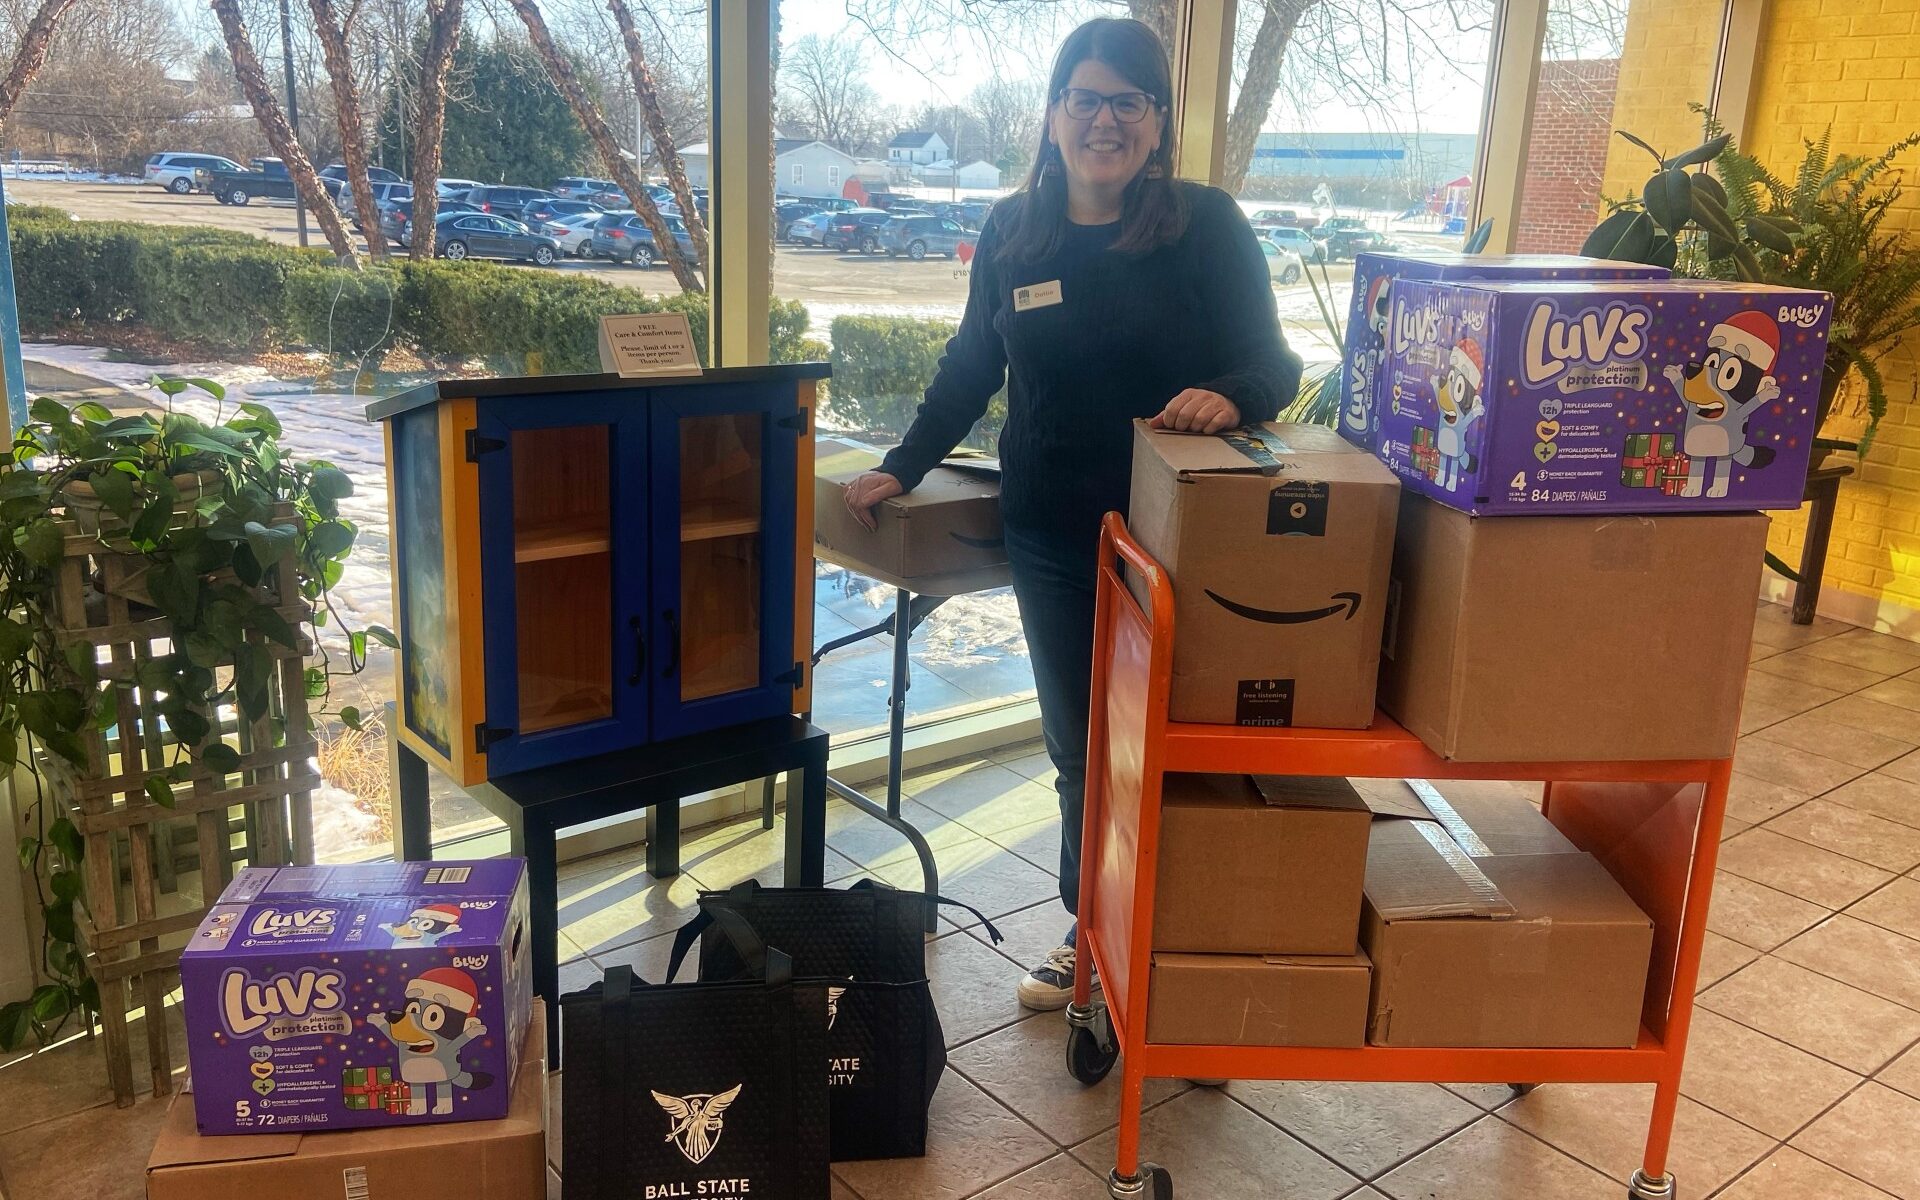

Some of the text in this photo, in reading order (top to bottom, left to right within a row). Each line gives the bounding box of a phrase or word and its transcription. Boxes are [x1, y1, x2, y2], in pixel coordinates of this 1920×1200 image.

[1778, 304, 1824, 328] BLUEY
[643, 343, 659, 351] limit
[1606, 365, 1640, 374] platinum
[1566, 374, 1640, 387] protection
[1542, 406, 1558, 415] 12h
[1382, 439, 1390, 458] 4
[1510, 471, 1527, 491] 4
[1531, 489, 1550, 502] 84
[1552, 491, 1576, 501] DIAPERS
[1257, 691, 1288, 700] listening
[460, 900, 497, 910] BLUEY
[355, 914, 367, 922] 5
[452, 954, 489, 970] BLUEY
[309, 1015, 344, 1023] platinum
[272, 1022, 345, 1036] protection
[236, 1100, 251, 1118] 5
[257, 1114, 276, 1126] 72
[277, 1115, 301, 1125] DIAPERS
[645, 1178, 750, 1200] BALL STATE
